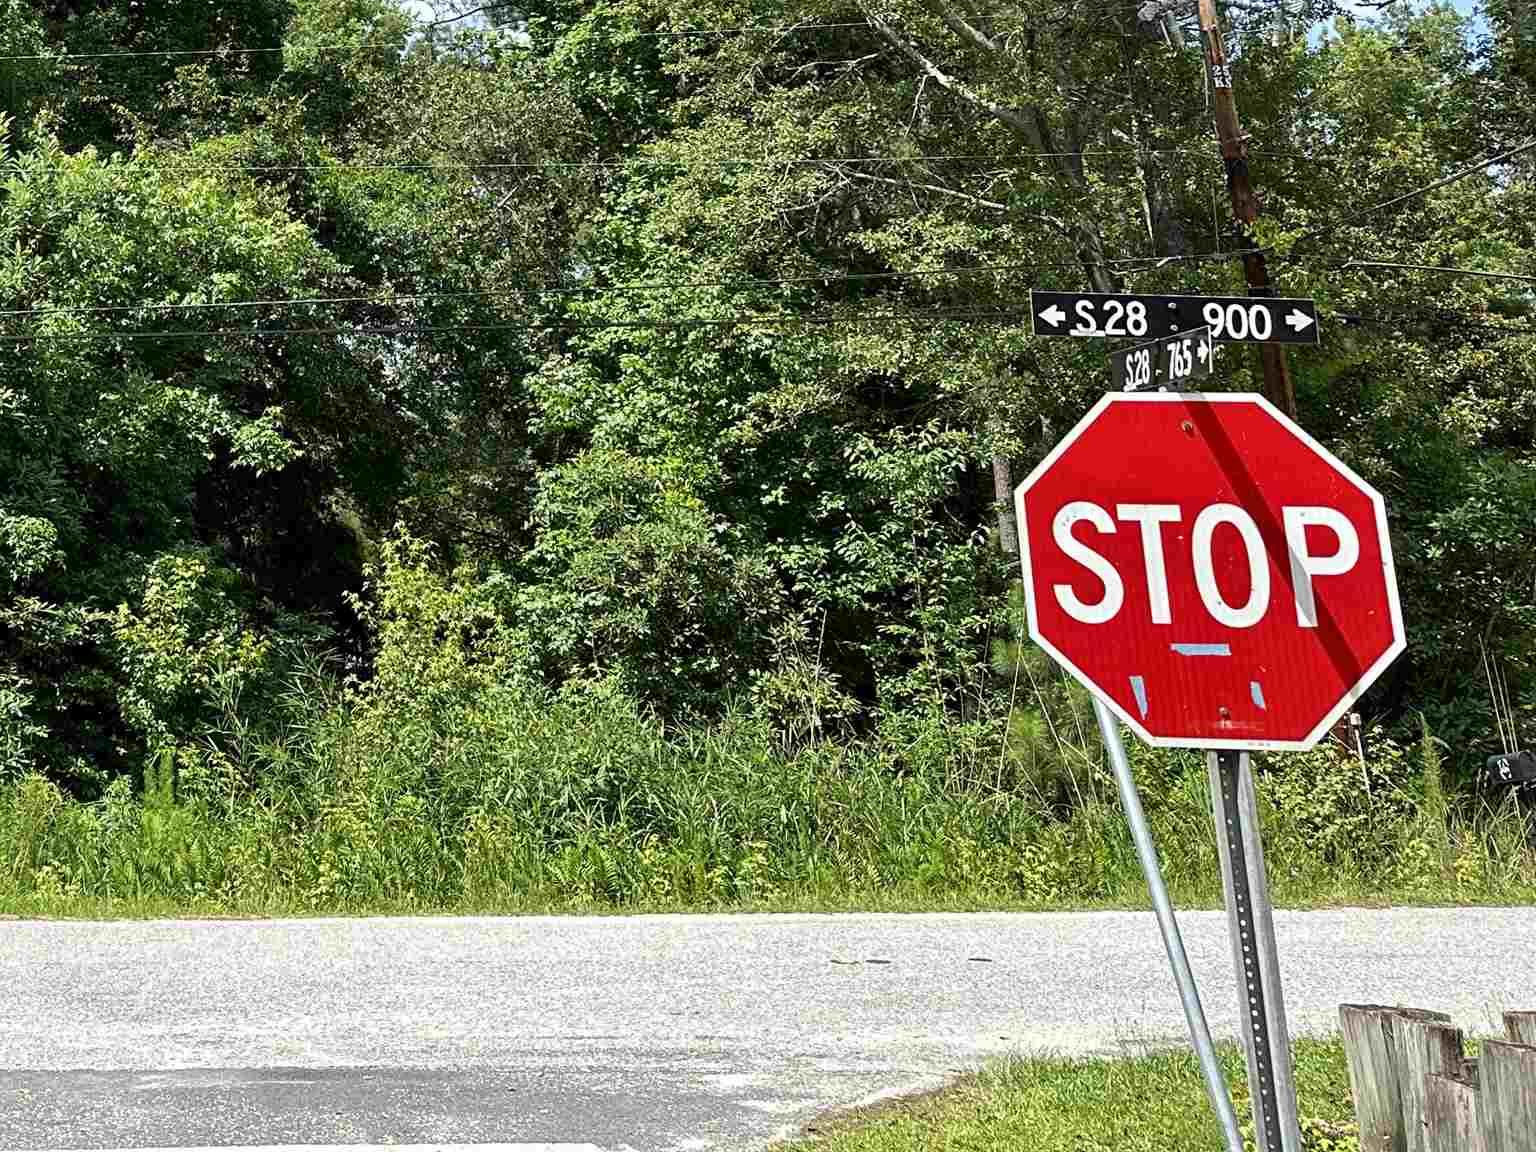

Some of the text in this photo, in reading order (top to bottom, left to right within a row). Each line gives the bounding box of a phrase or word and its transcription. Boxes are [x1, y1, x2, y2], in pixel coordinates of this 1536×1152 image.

[1202, 303, 1272, 340] 900
[1166, 339, 1193, 379] 765
[1051, 500, 1361, 629] STOP
